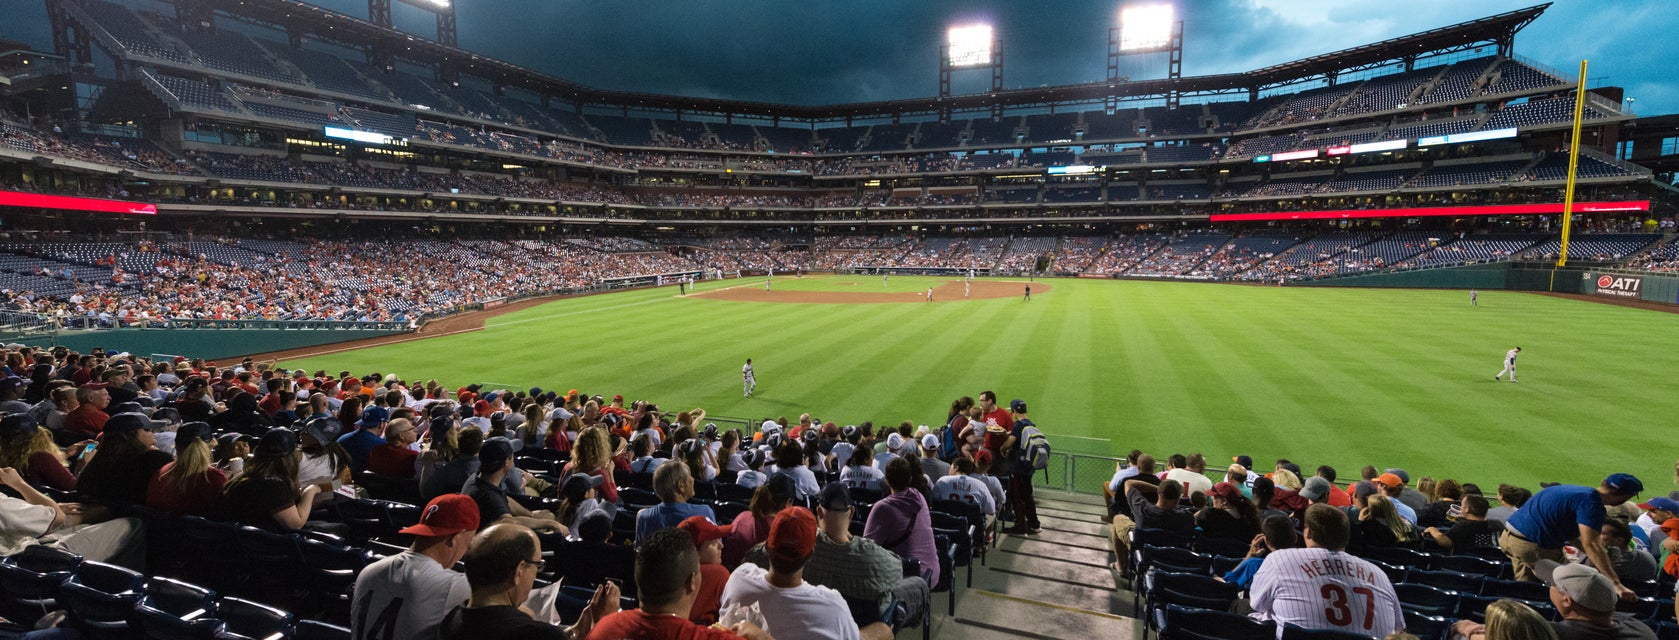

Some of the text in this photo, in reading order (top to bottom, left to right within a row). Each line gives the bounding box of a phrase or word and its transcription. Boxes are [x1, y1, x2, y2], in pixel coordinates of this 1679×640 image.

[1611, 277, 1640, 291] ATI
[425, 504, 439, 520] P
[1300, 558, 1375, 585] HERRERA
[356, 589, 404, 640] 14
[1320, 583, 1375, 630] 37
